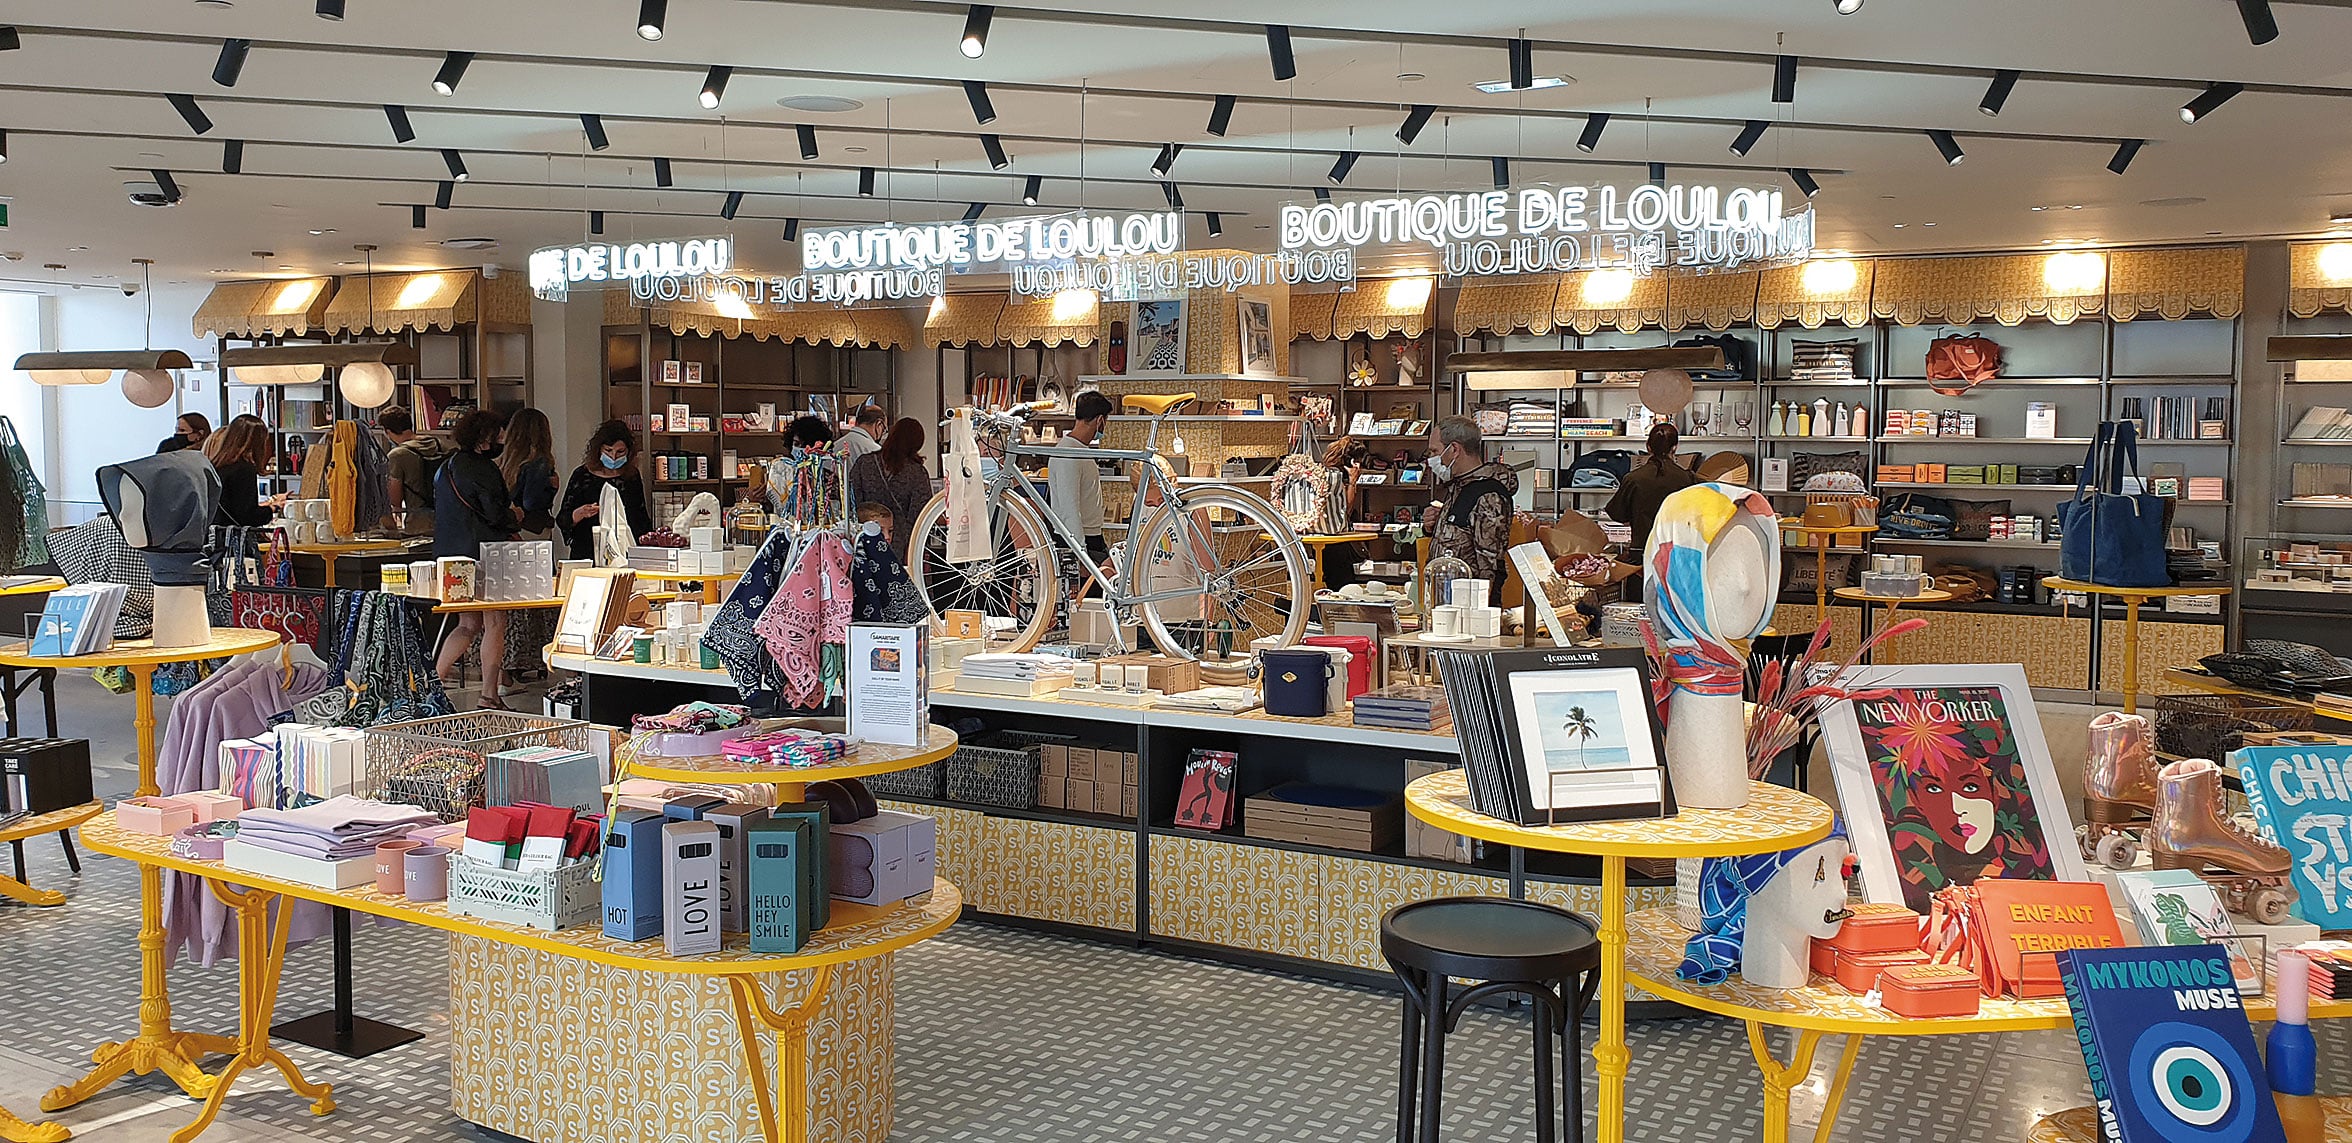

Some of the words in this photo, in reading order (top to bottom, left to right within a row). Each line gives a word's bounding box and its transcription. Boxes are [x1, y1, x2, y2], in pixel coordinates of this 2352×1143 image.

[1281, 189, 1508, 249] BOUTIQUE
[1518, 186, 1589, 234] DE
[1601, 184, 1784, 237] LOULOU
[803, 223, 971, 271] BOUTIQUE
[976, 222, 1026, 263] DE
[1029, 211, 1179, 261] LOULOU
[567, 246, 609, 282] DE
[610, 238, 728, 280] LOULOU
[1795, 569, 1836, 581] LIBETÉ
[48, 599, 83, 611] ELLE
[1914, 690, 1938, 700] THE
[1862, 702, 1910, 724] NEW
[1909, 700, 1999, 723] YORKER
[2269, 752, 2352, 806] CHI
[2240, 766, 2268, 821] CHIC
[2291, 811, 2352, 866] ST
[376, 863, 390, 875] OVE
[404, 871, 417, 881] OVE
[684, 879, 709, 936] LOVE
[755, 895, 791, 909] HELLO
[607, 906, 628, 925] HOT
[755, 910, 778, 923] HEY
[2009, 904, 2094, 923] ENFANT
[755, 924, 790, 938] SMILE
[2010, 933, 2113, 951] TERRIBLE
[2086, 958, 2230, 990] MYKONOS
[2173, 987, 2240, 1011] MUSE
[2062, 973, 2108, 1099] MYKONOS
[2098, 1099, 2123, 1143] MU
